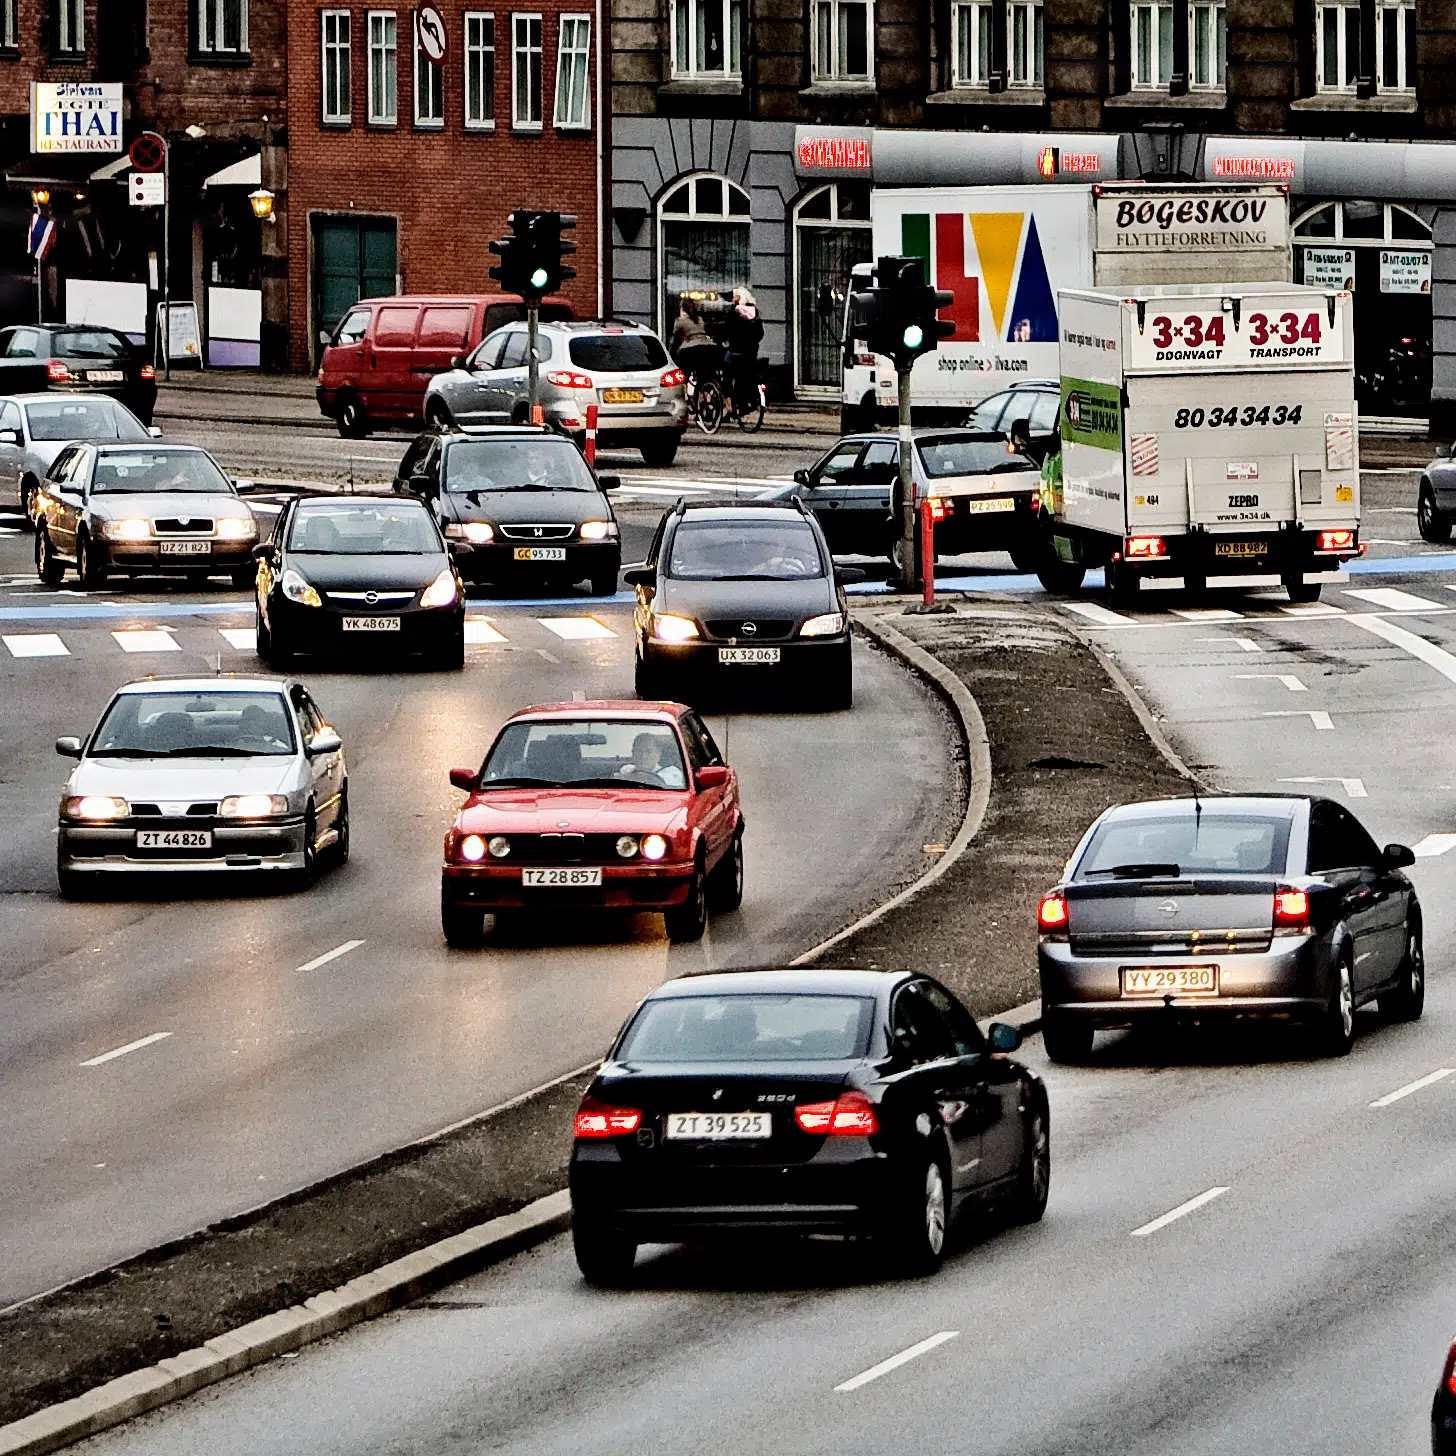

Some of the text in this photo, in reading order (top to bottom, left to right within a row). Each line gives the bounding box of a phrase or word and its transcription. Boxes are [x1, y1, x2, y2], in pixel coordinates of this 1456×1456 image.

[39, 111, 119, 136] THAI
[39, 139, 120, 151] RESTAURANT
[1115, 199, 1268, 231] BØGESKOV
[1116, 231, 1268, 247] FLYTTEFORRETNING
[1155, 348, 1224, 362] DØGNVAGT
[1248, 346, 1322, 359] TRANSPORT
[938, 355, 1029, 375] shop online ilva.com
[1174, 407, 1205, 429] 80
[1207, 406, 1239, 428] 34
[1240, 405, 1271, 427] 34
[1272, 404, 1303, 426] 34
[1228, 495, 1259, 508] ZEPRO
[162, 542, 176, 552] UZ
[177, 542, 188, 552] 21
[517, 549, 562, 559] GC 95 733
[345, 619, 360, 629] YK
[720, 650, 779, 661] UX 32 063
[143, 833, 160, 846] ZT
[524, 870, 546, 884] TZ
[1129, 970, 1210, 987] YY 29 380
[676, 1115, 763, 1134] ZT 39 525
